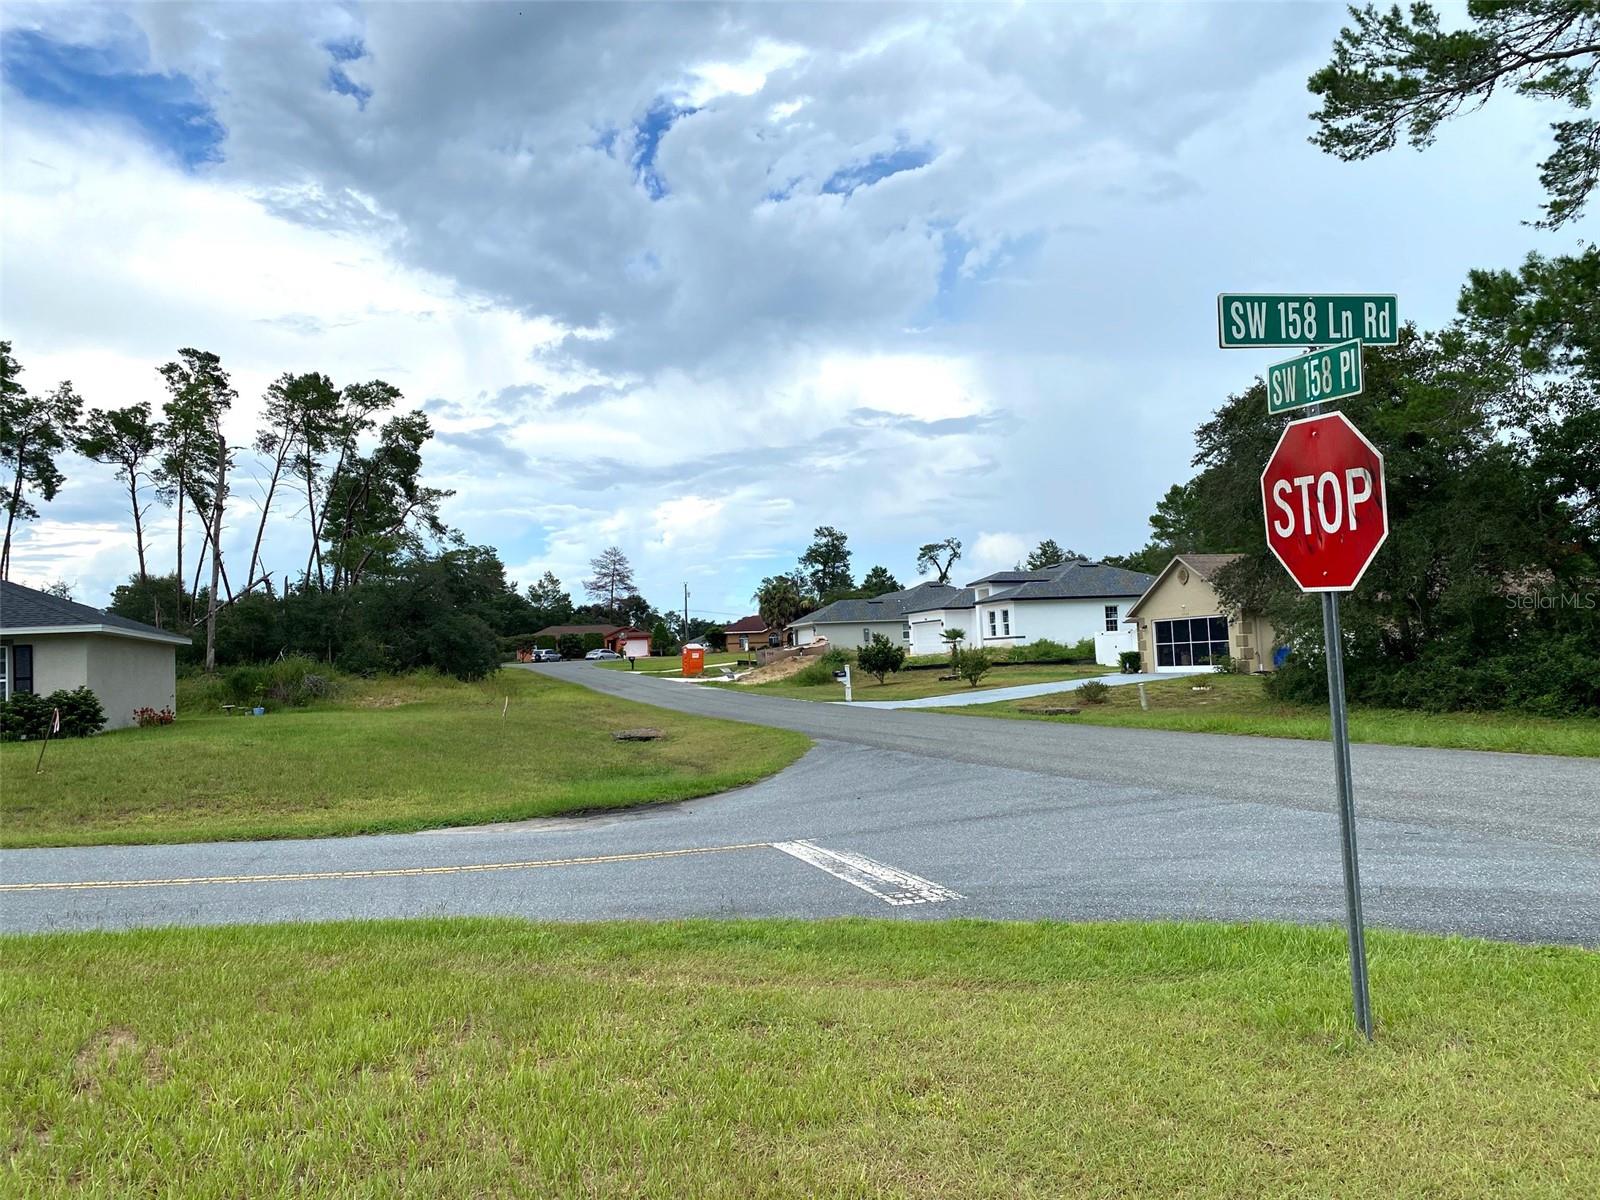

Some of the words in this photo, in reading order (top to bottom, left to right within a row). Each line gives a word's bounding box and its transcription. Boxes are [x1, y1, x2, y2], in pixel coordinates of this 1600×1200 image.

[1230, 301, 1267, 340] SW
[1277, 301, 1318, 340] 158
[1328, 302, 1353, 339] Ln
[1364, 302, 1391, 339] Rd
[1272, 365, 1297, 406] SW
[1303, 355, 1333, 398] 158
[1272, 466, 1373, 539] STOP
